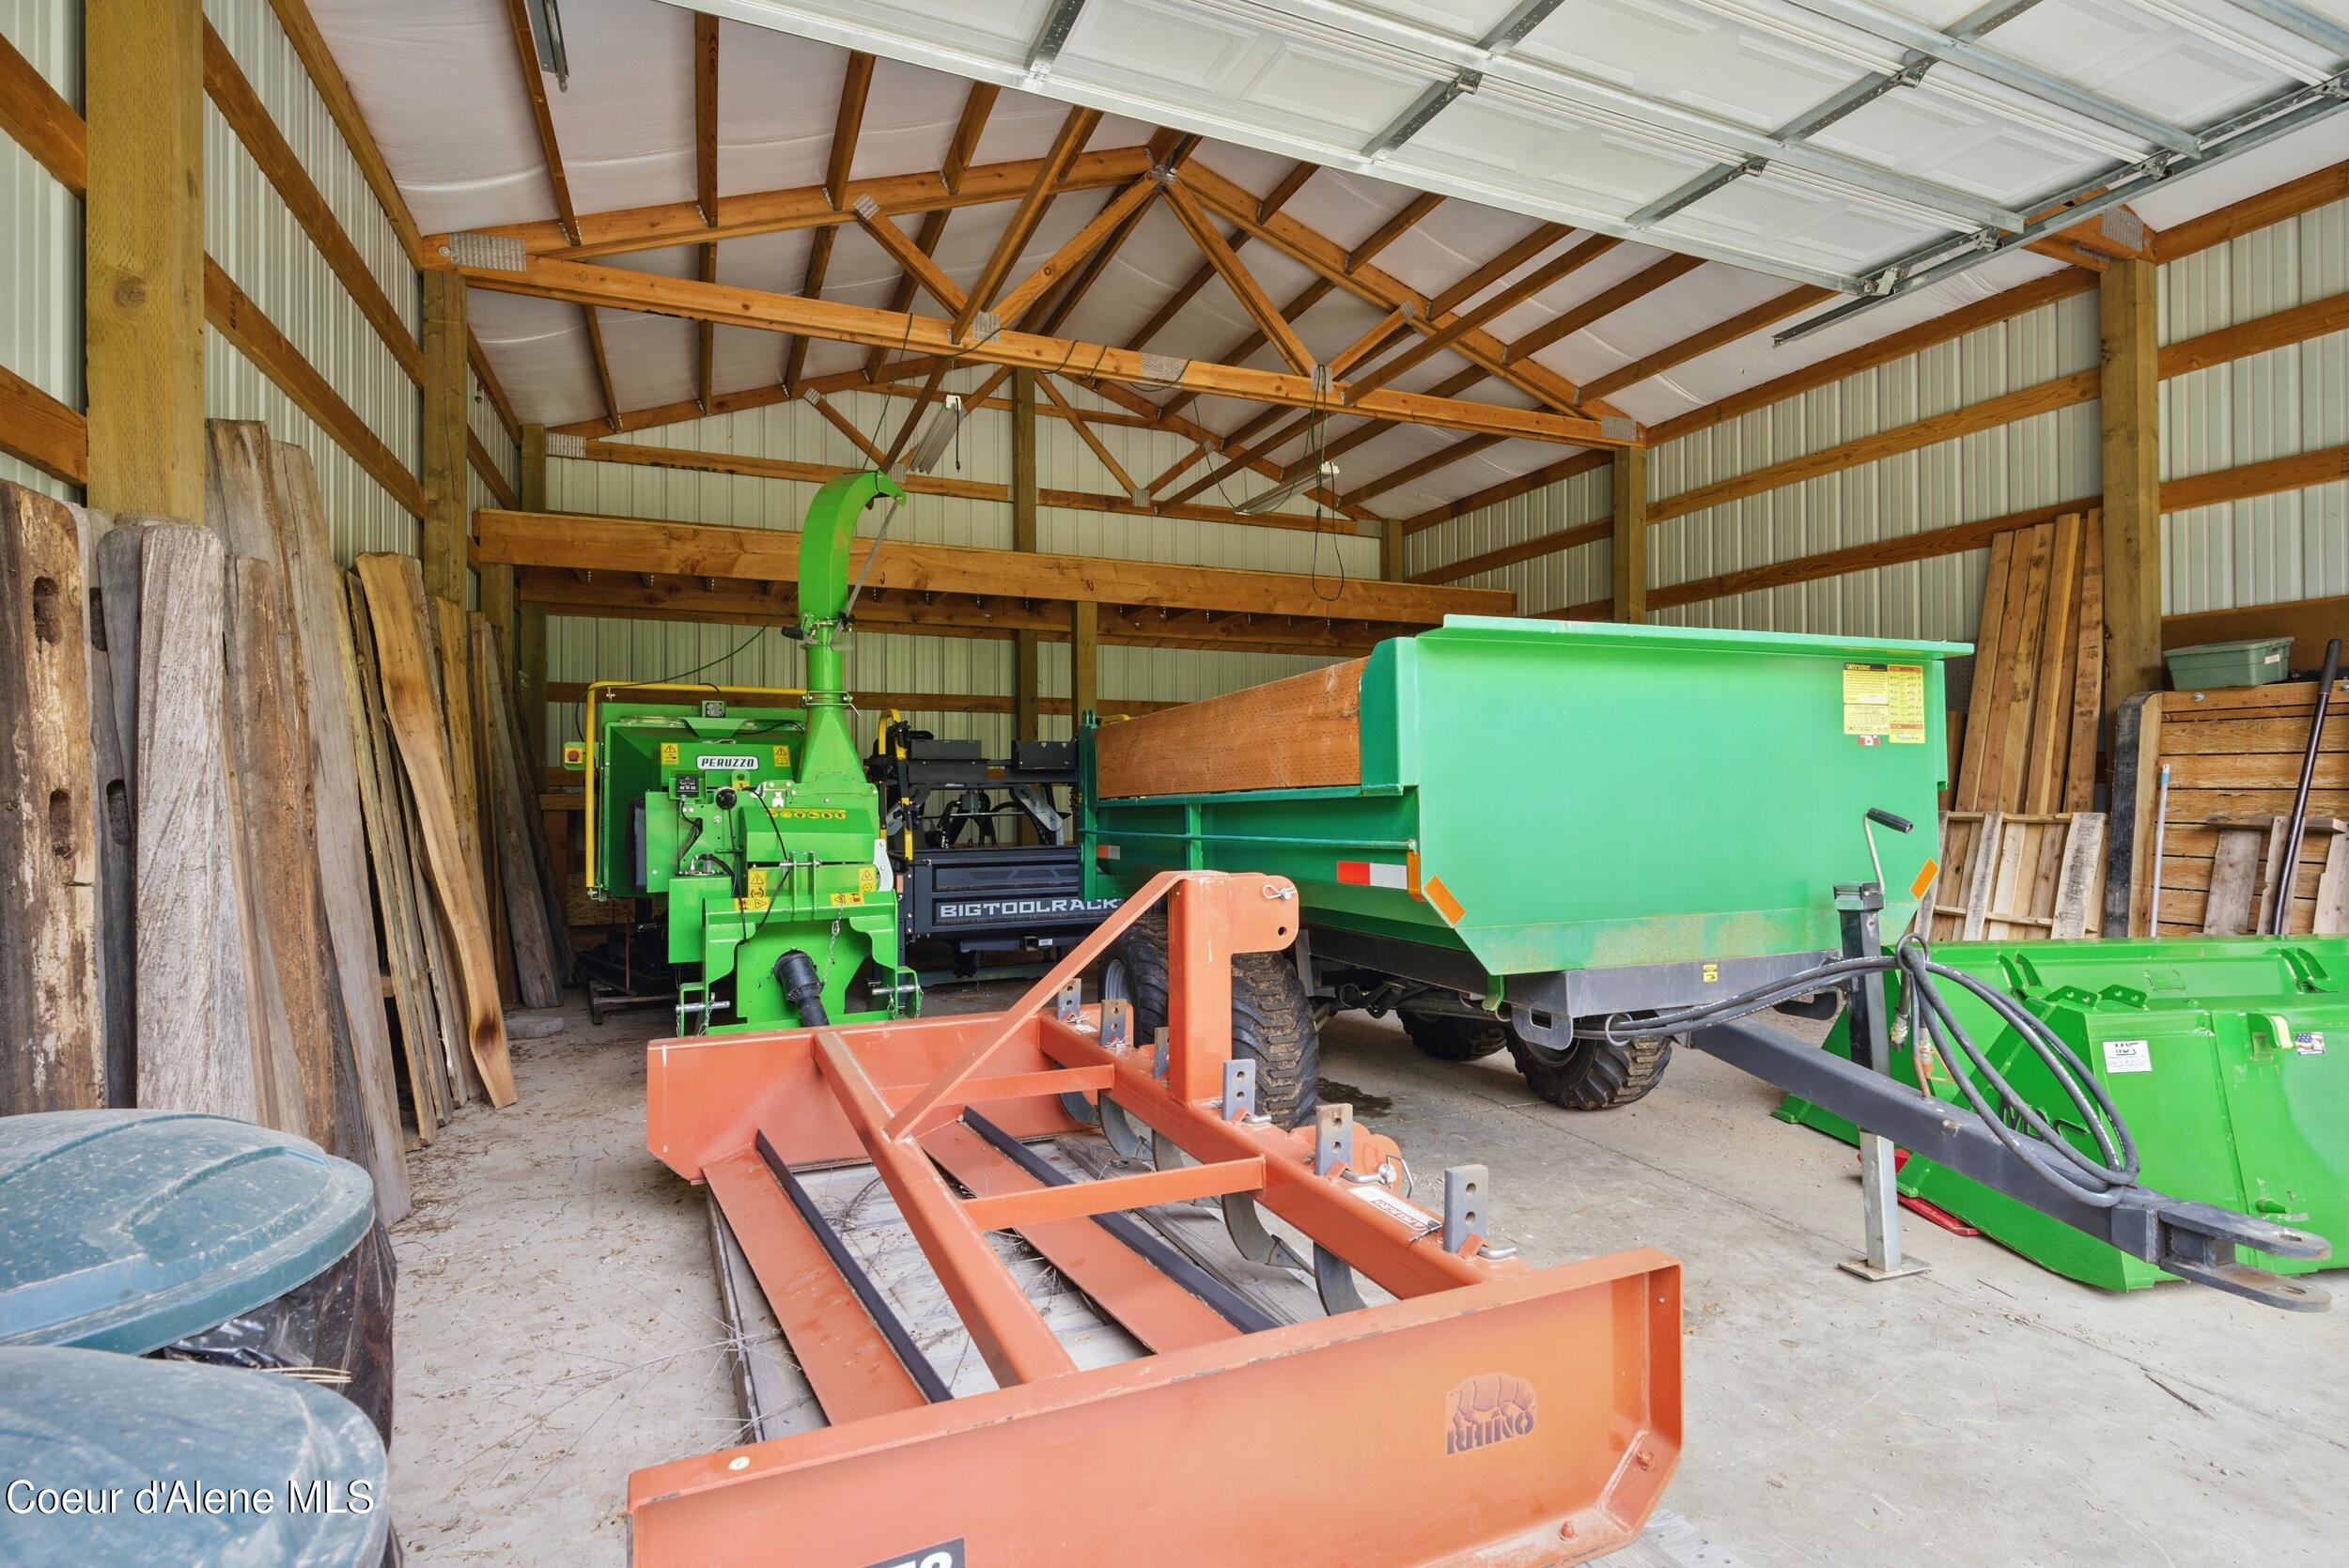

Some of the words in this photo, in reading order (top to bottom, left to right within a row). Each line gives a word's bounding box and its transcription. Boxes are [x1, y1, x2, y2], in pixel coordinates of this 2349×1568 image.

[701, 758, 754, 768] PERUZZO
[941, 898, 1118, 918] BIGTOOLRACK
[1446, 1411, 1534, 1455] RHINO
